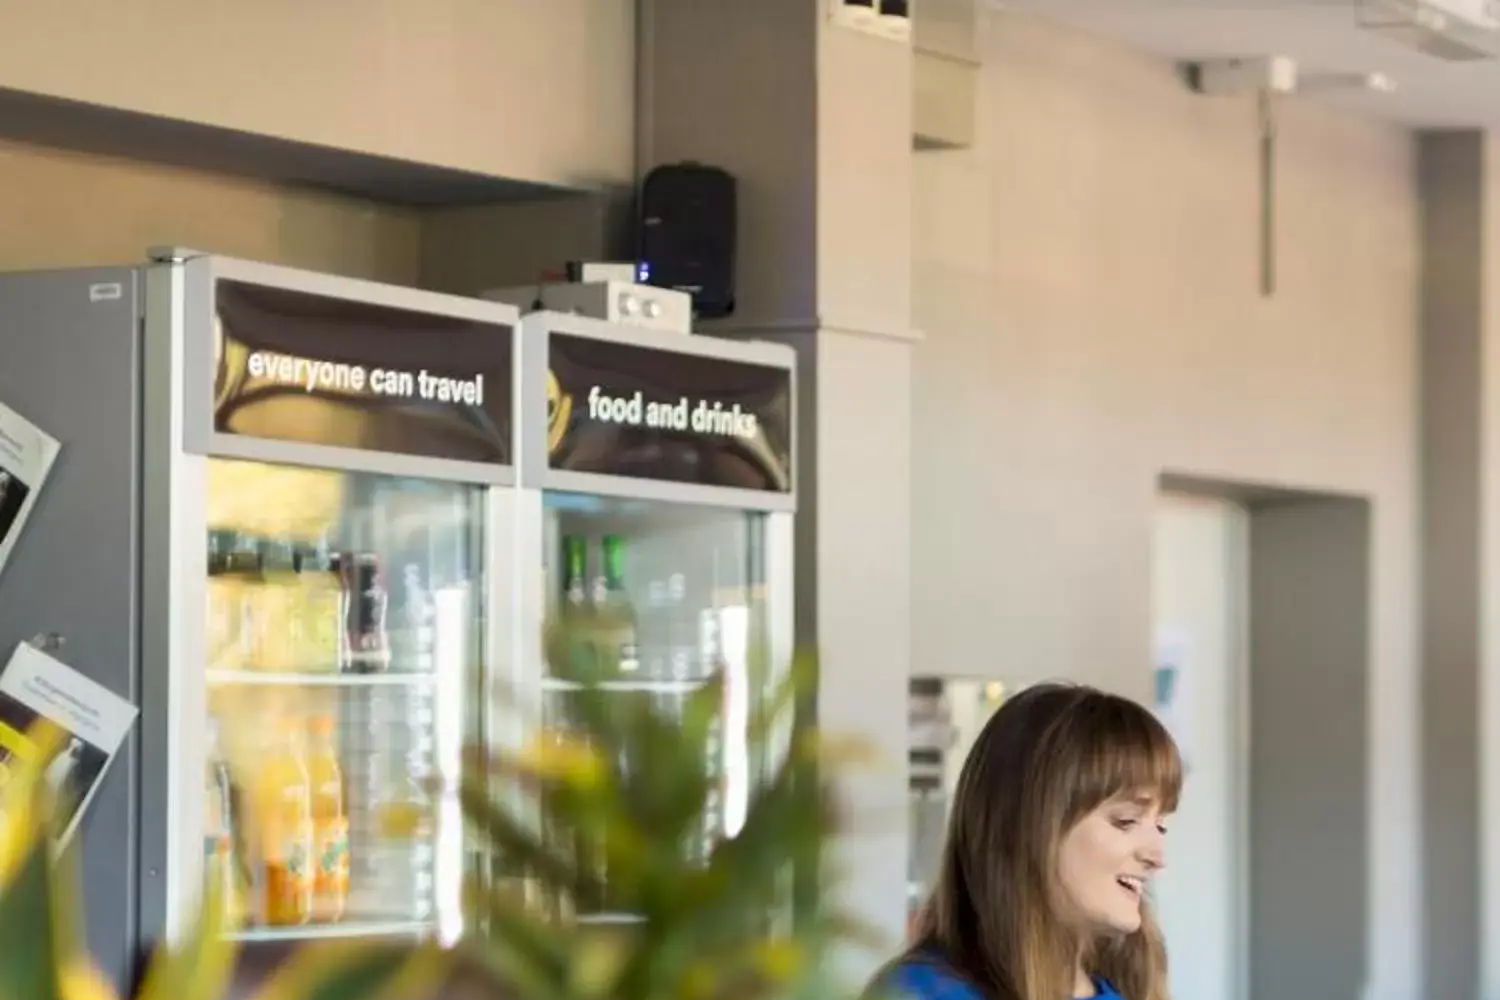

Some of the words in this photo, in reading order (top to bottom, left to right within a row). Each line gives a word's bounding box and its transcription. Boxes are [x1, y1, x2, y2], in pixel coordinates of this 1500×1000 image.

[249, 351, 365, 392] everyone
[370, 368, 413, 397] can
[418, 369, 483, 406] travel
[588, 385, 642, 424] food
[646, 397, 688, 430] and
[691, 400, 757, 438] drinks
